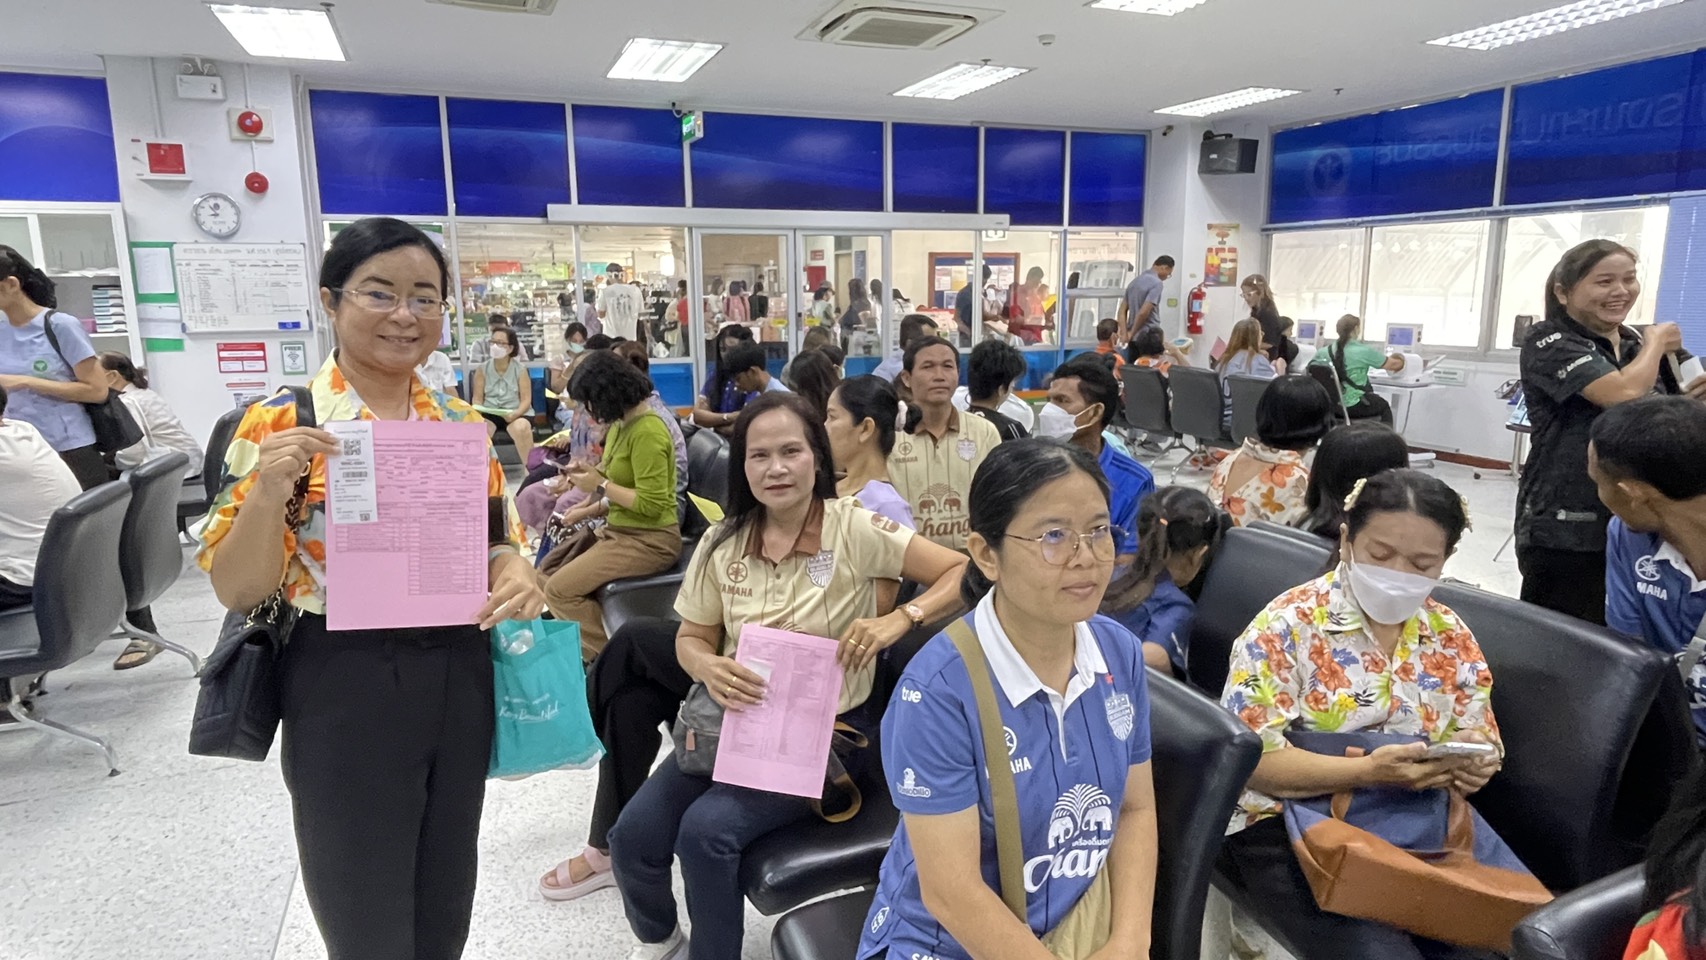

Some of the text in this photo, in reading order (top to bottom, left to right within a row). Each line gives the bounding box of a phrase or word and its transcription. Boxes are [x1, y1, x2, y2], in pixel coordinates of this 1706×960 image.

[1535, 332, 1562, 348] true
[720, 584, 753, 598] AMAHA
[1636, 581, 1668, 600] MAHA
[901, 686, 922, 703] true
